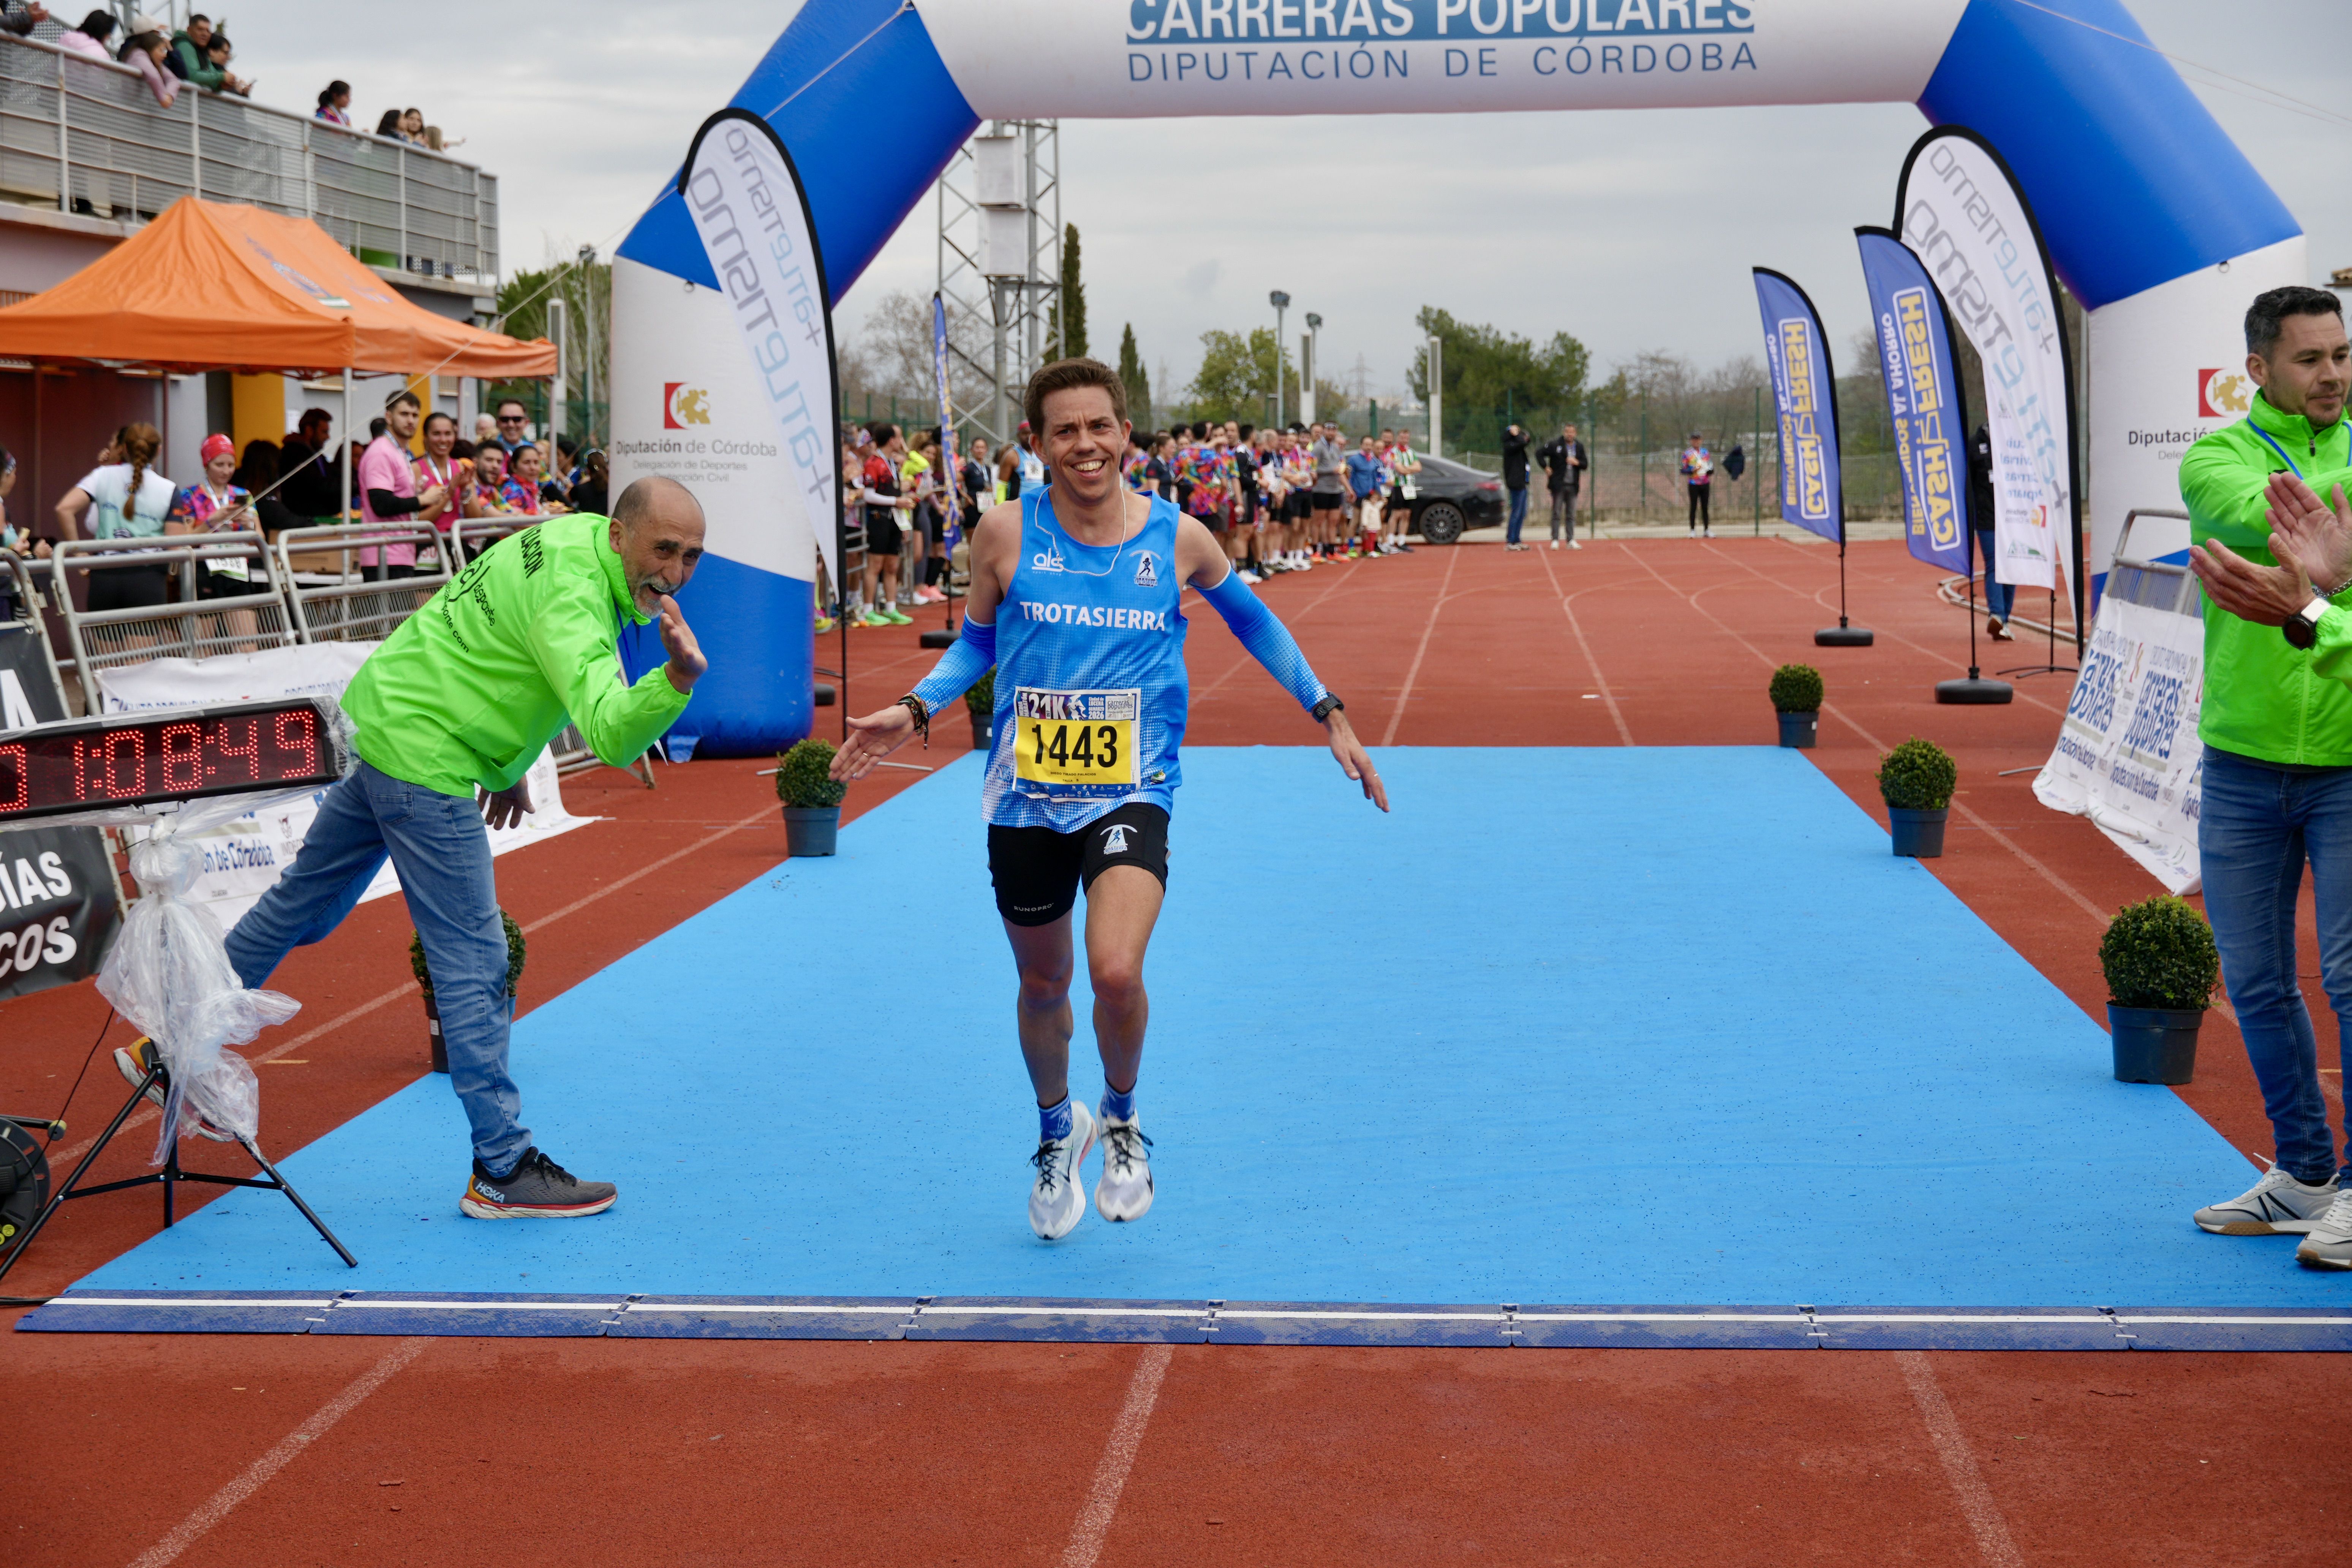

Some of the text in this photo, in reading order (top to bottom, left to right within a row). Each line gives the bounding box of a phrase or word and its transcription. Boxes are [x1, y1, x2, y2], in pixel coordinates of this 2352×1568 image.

[1127, 0, 1755, 40] CARRERAS POPULARES
[1129, 37, 1757, 81] DIPUTACIÓN DE CÓRDOBA
[616, 438, 777, 457] Diputación de Córdoba
[633, 459, 748, 471] Delegación de Deportes
[707, 473, 729, 482] Civil
[1020, 601, 1165, 631] TROTASIERRA
[1029, 693, 1067, 719] 21K
[1089, 711, 1104, 719] 2026
[1032, 724, 1118, 768] 1443
[228, 839, 277, 870] Córdoba
[0, 850, 72, 912] ÍAS
[475, 1182, 505, 1203] HOKA
